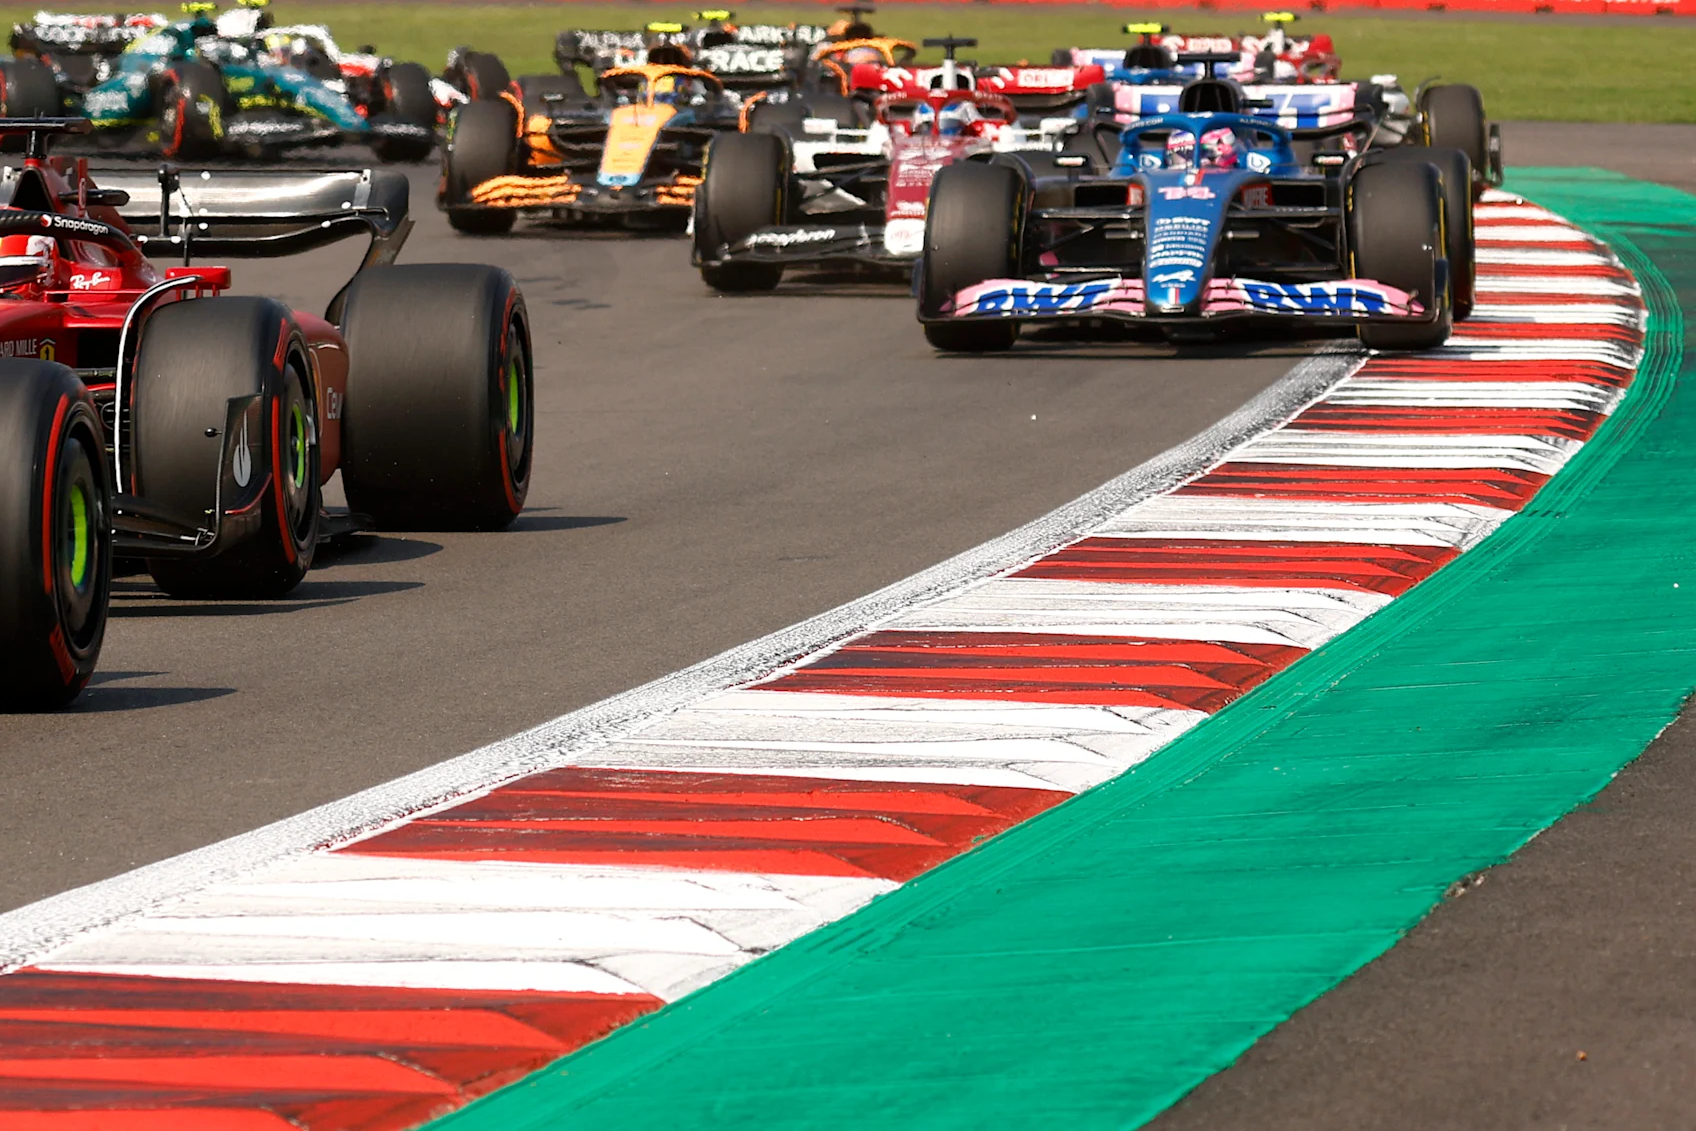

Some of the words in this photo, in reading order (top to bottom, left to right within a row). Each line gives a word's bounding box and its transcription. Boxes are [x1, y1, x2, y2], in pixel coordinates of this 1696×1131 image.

[54, 216, 109, 235] Snapdragon
[975, 283, 1111, 316] BWT
[15, 338, 38, 355] MILLE
